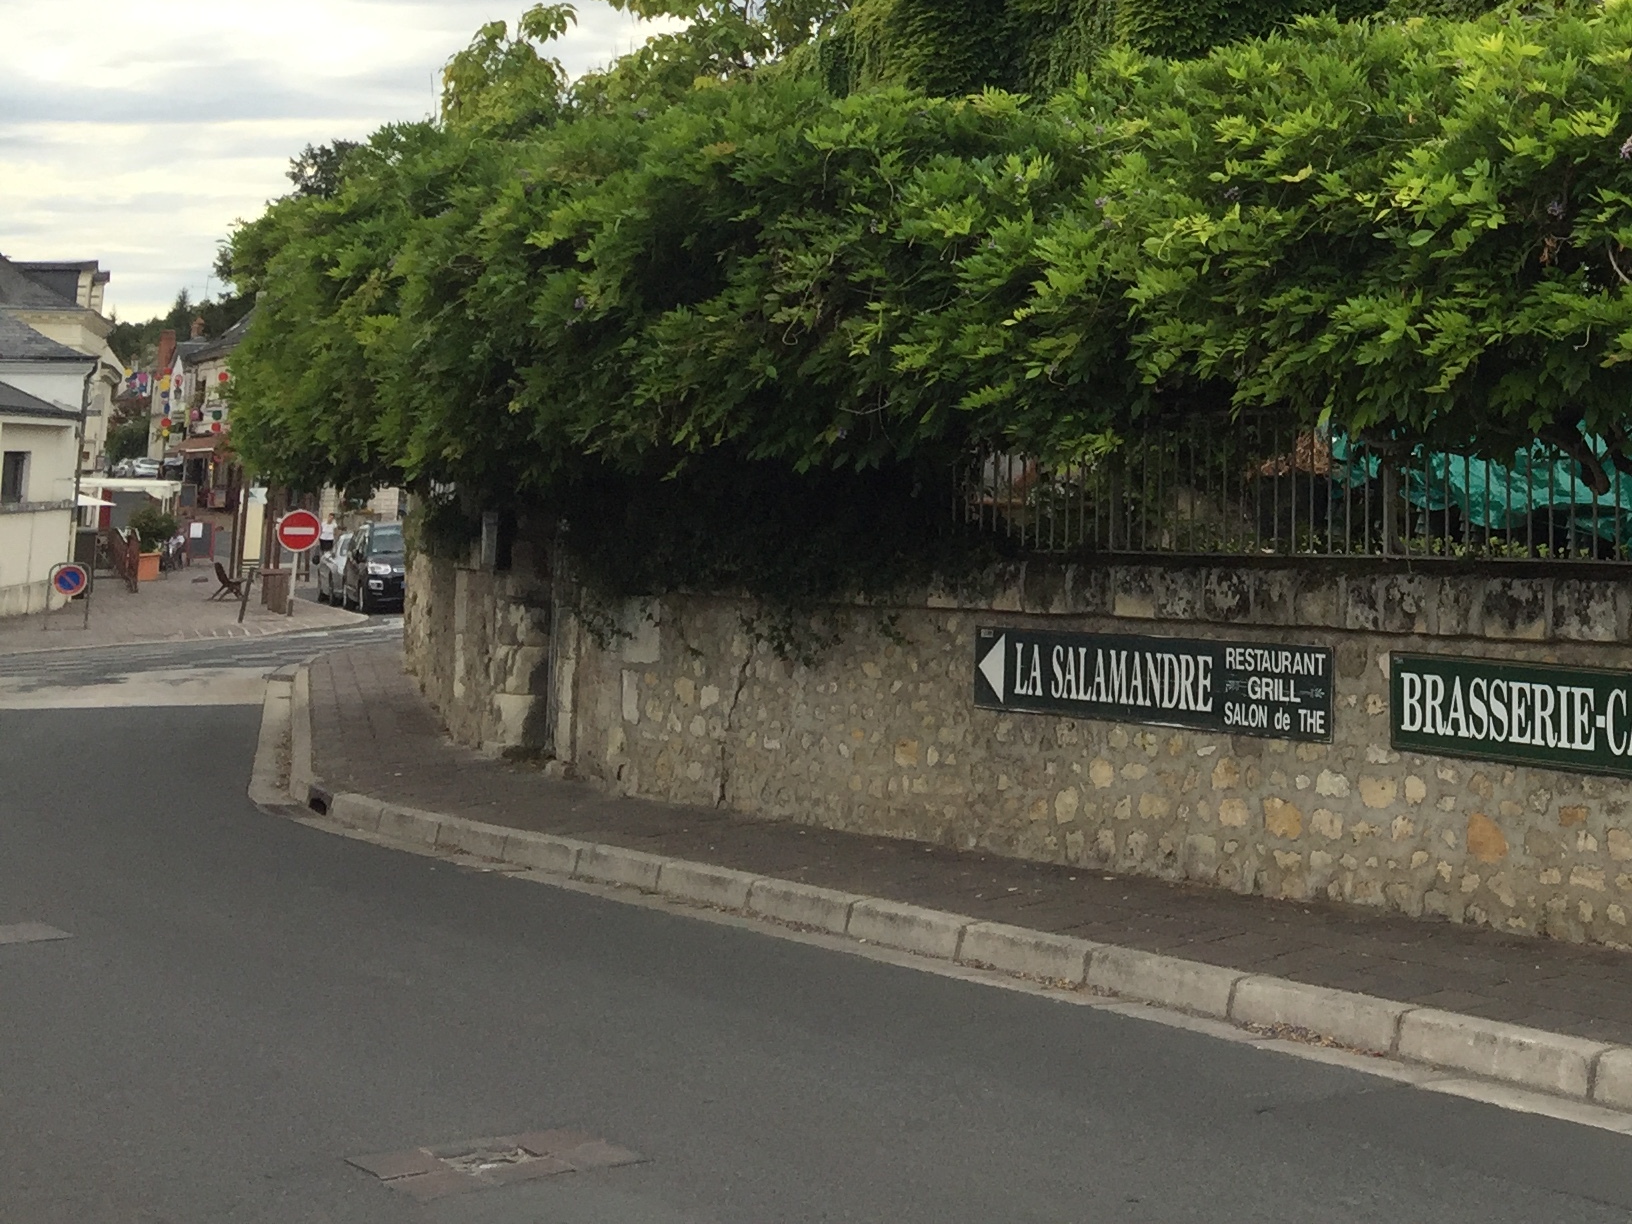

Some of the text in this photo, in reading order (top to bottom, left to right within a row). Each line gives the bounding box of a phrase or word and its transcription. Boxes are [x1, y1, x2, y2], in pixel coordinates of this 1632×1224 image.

[1014, 642, 1213, 713] LA SALAMANDRE
[1225, 647, 1327, 677] RESTAURANT
[1247, 676, 1302, 703] GRILL
[1223, 701, 1326, 735] SALON de THE
